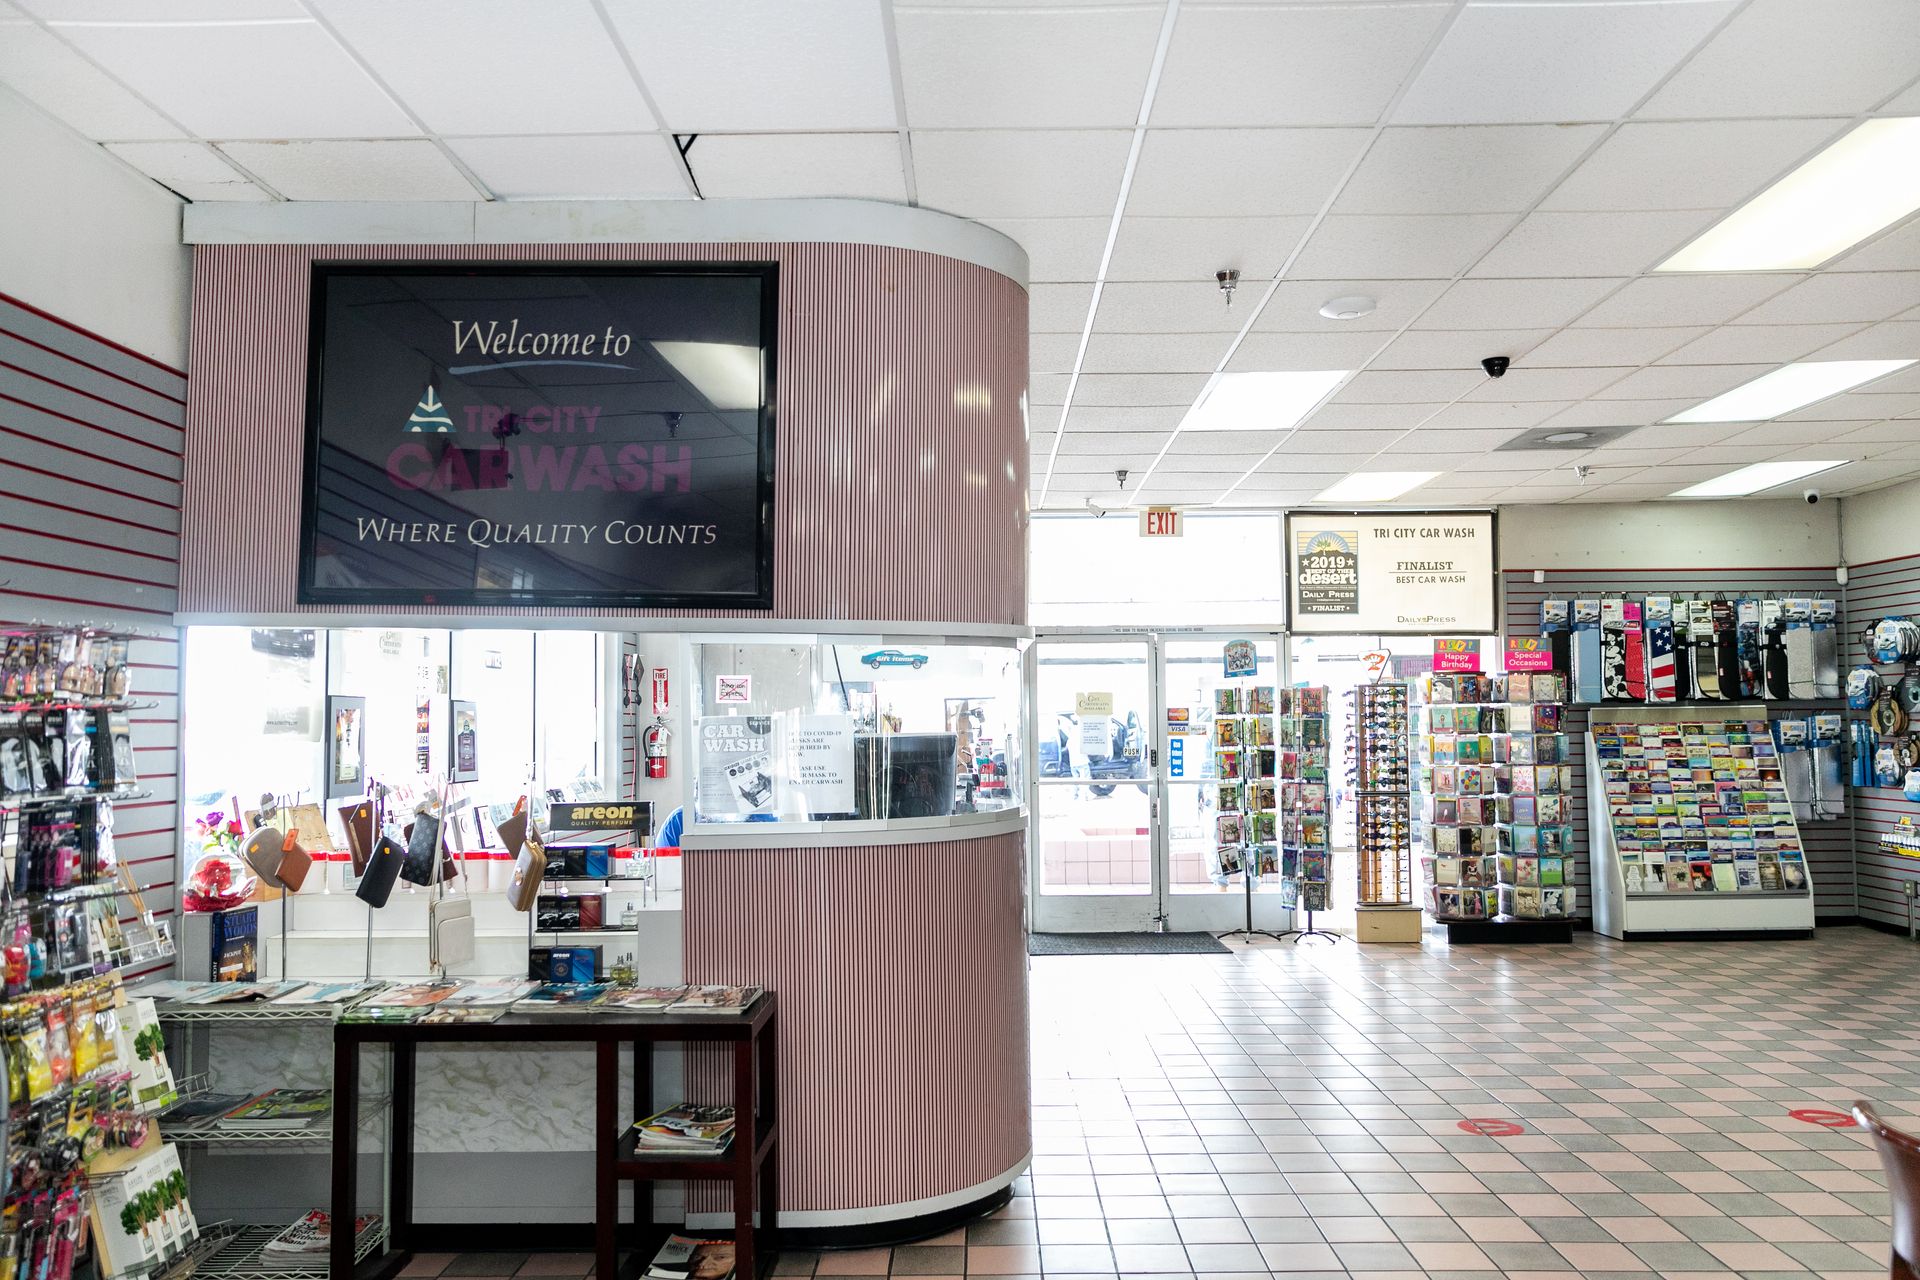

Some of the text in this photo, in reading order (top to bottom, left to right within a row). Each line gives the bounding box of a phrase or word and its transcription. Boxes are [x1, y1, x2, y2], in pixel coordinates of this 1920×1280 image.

[452, 319, 631, 356] Welcome to
[1147, 512, 1177, 535] EXIT
[357, 517, 718, 548] WHERE QUALITY COUNTS
[1373, 528, 1475, 538] TRI CITY CAR WASH
[1310, 556, 1346, 568] 2019
[1397, 561, 1454, 571] FINALIST
[1299, 569, 1358, 585] desert
[1439, 575, 1466, 583] WASH
[1444, 653, 1469, 661] Happy
[1514, 652, 1542, 660] Special
[1441, 661, 1473, 669] Birthday
[655, 672, 666, 680] FIRE
[703, 724, 745, 738] CAR
[703, 738, 766, 753] WASH
[571, 805, 634, 820] areon
[223, 911, 257, 927] STUART
[276, 1236, 307, 1245] Diana
[290, 1230, 328, 1241] Without
